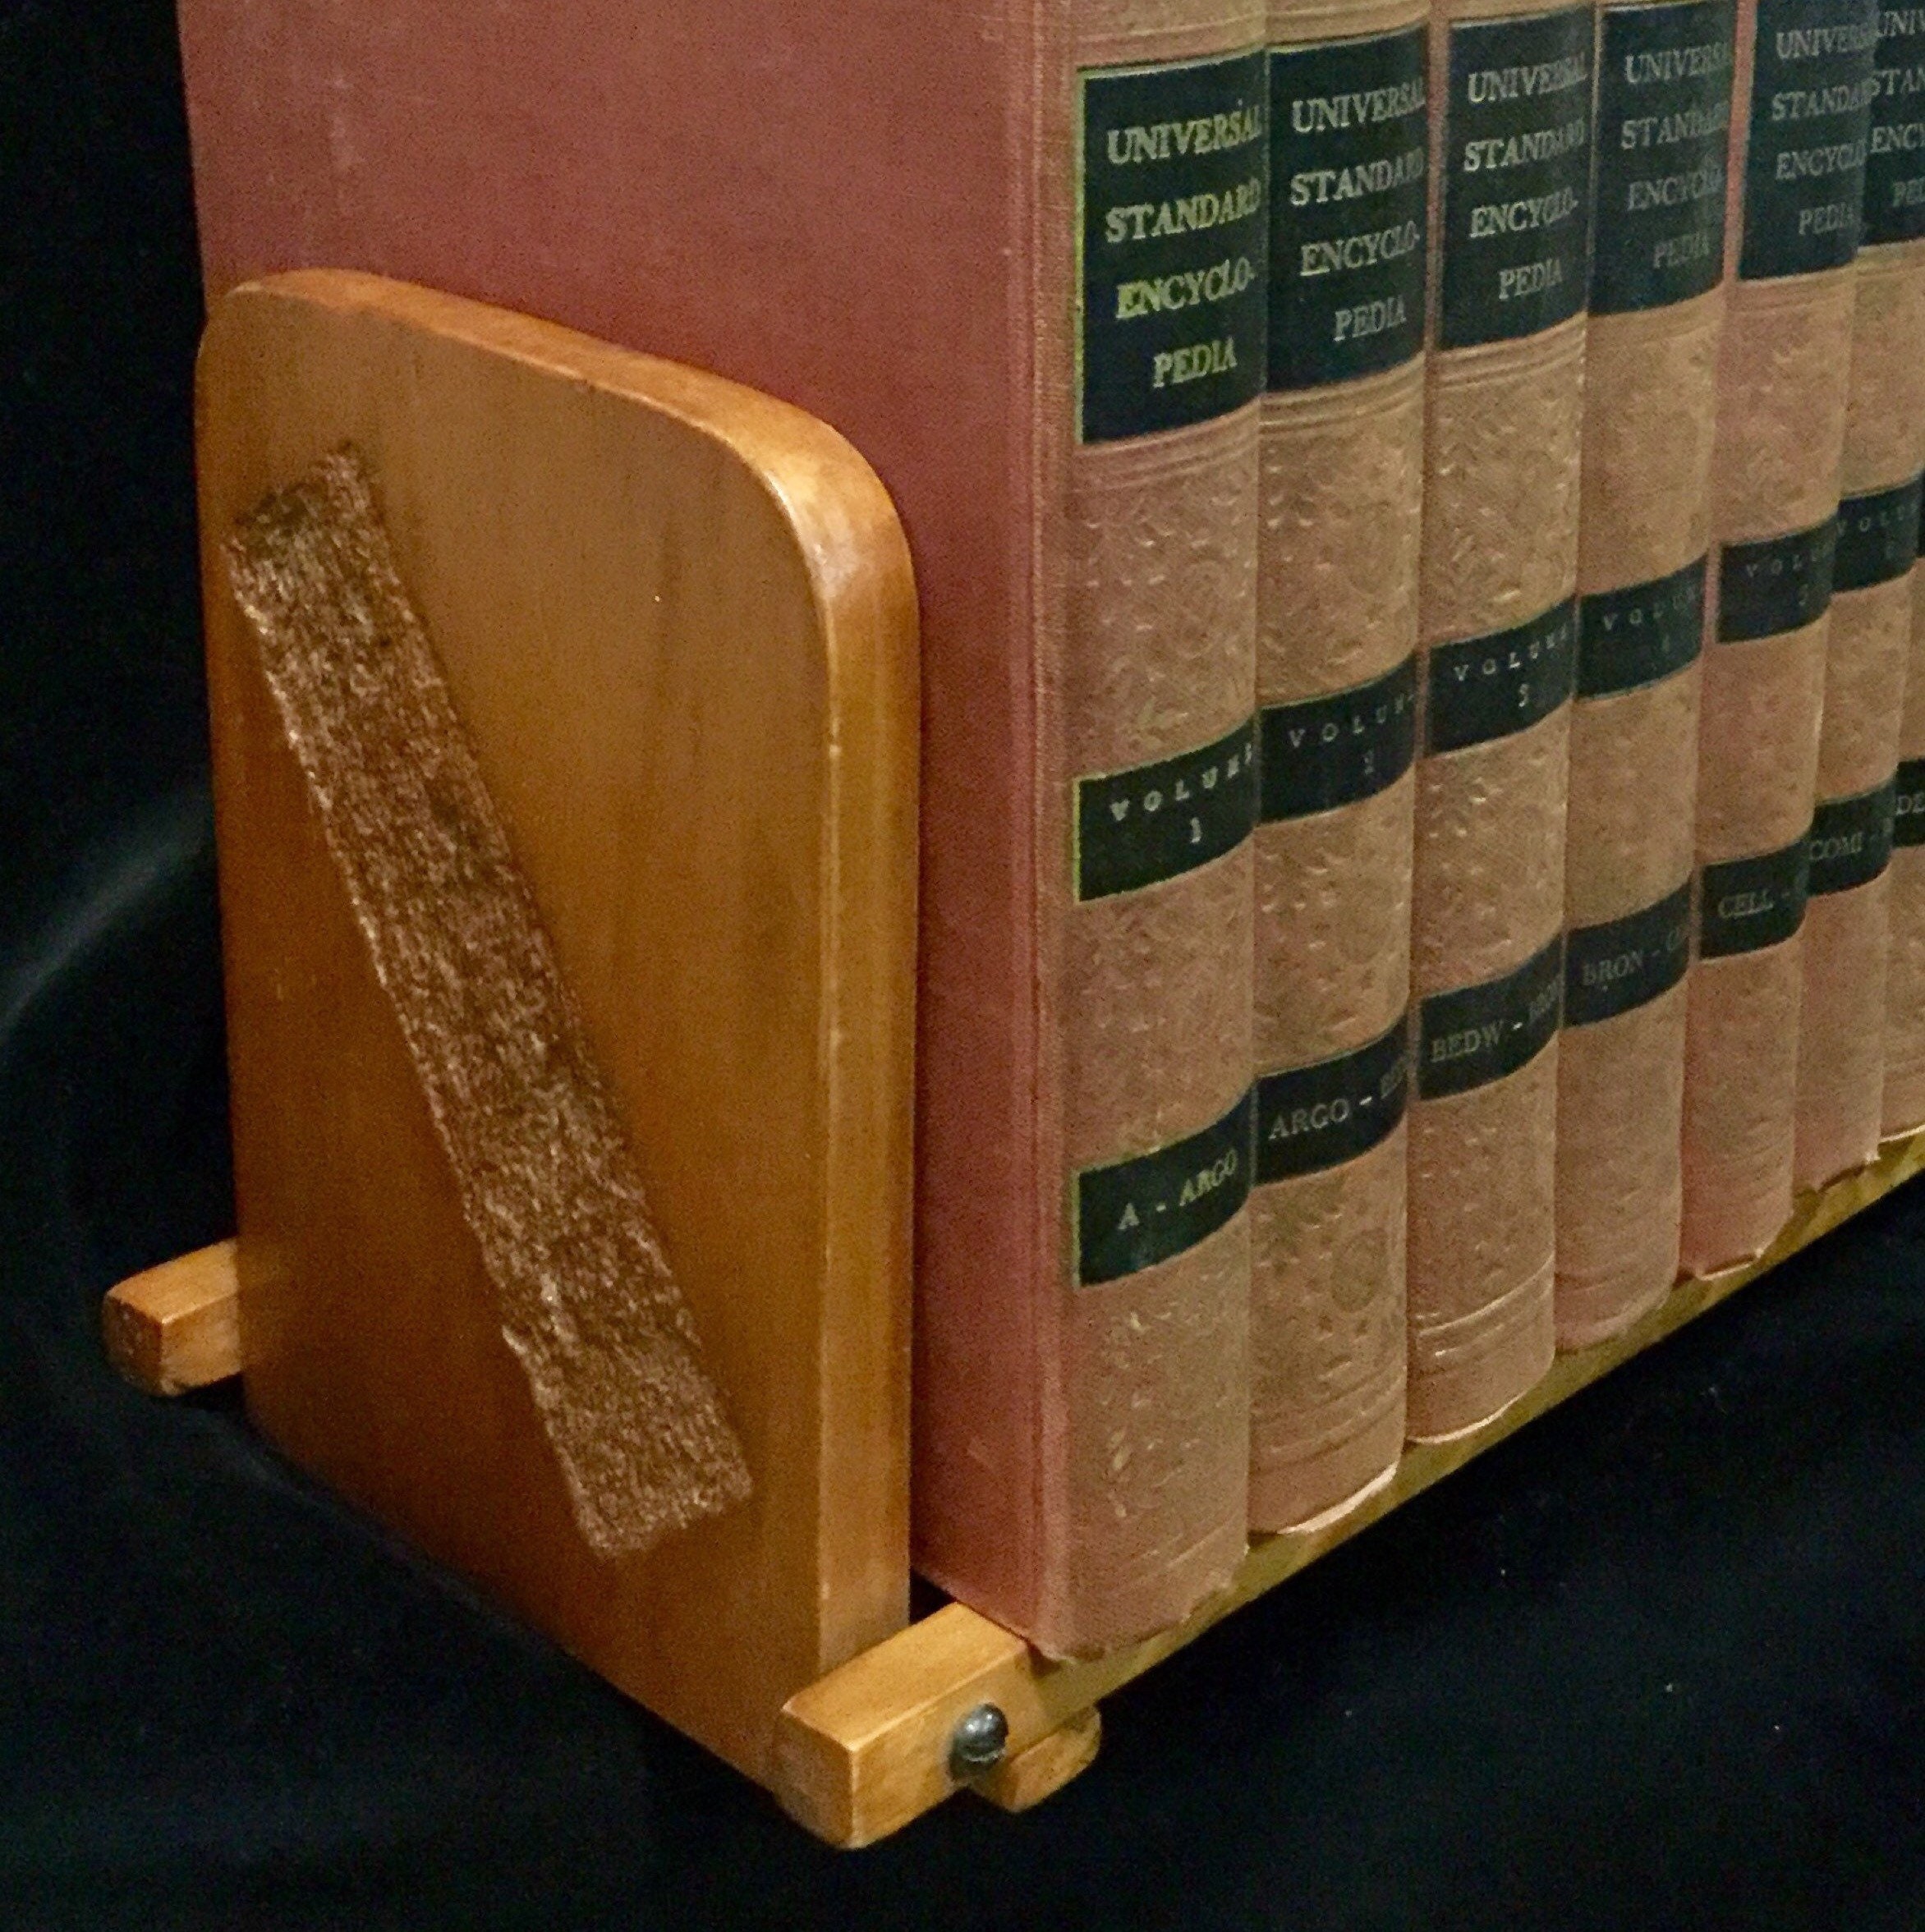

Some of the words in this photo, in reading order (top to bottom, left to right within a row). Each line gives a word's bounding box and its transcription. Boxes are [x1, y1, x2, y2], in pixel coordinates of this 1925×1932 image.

[1292, 79, 1426, 134] UNIVERSAL
[1107, 106, 1262, 165] UNIVERSAL
[1290, 147, 1425, 206] STANDARD
[1105, 177, 1261, 244] STANDARD
[1300, 220, 1420, 277] ENCYCLO-
[1116, 257, 1255, 319] ENCYCLO-
[1499, 257, 1563, 300] PEDIA
[1334, 296, 1407, 342] PEDIA
[1153, 337, 1238, 388] PEDIA
[1189, 815, 1202, 844] 1
[1431, 1021, 1505, 1063] BEDW
[1268, 1098, 1349, 1140] ARGO
[1118, 1201, 1140, 1231] A
[1179, 1148, 1238, 1207] ARGO
